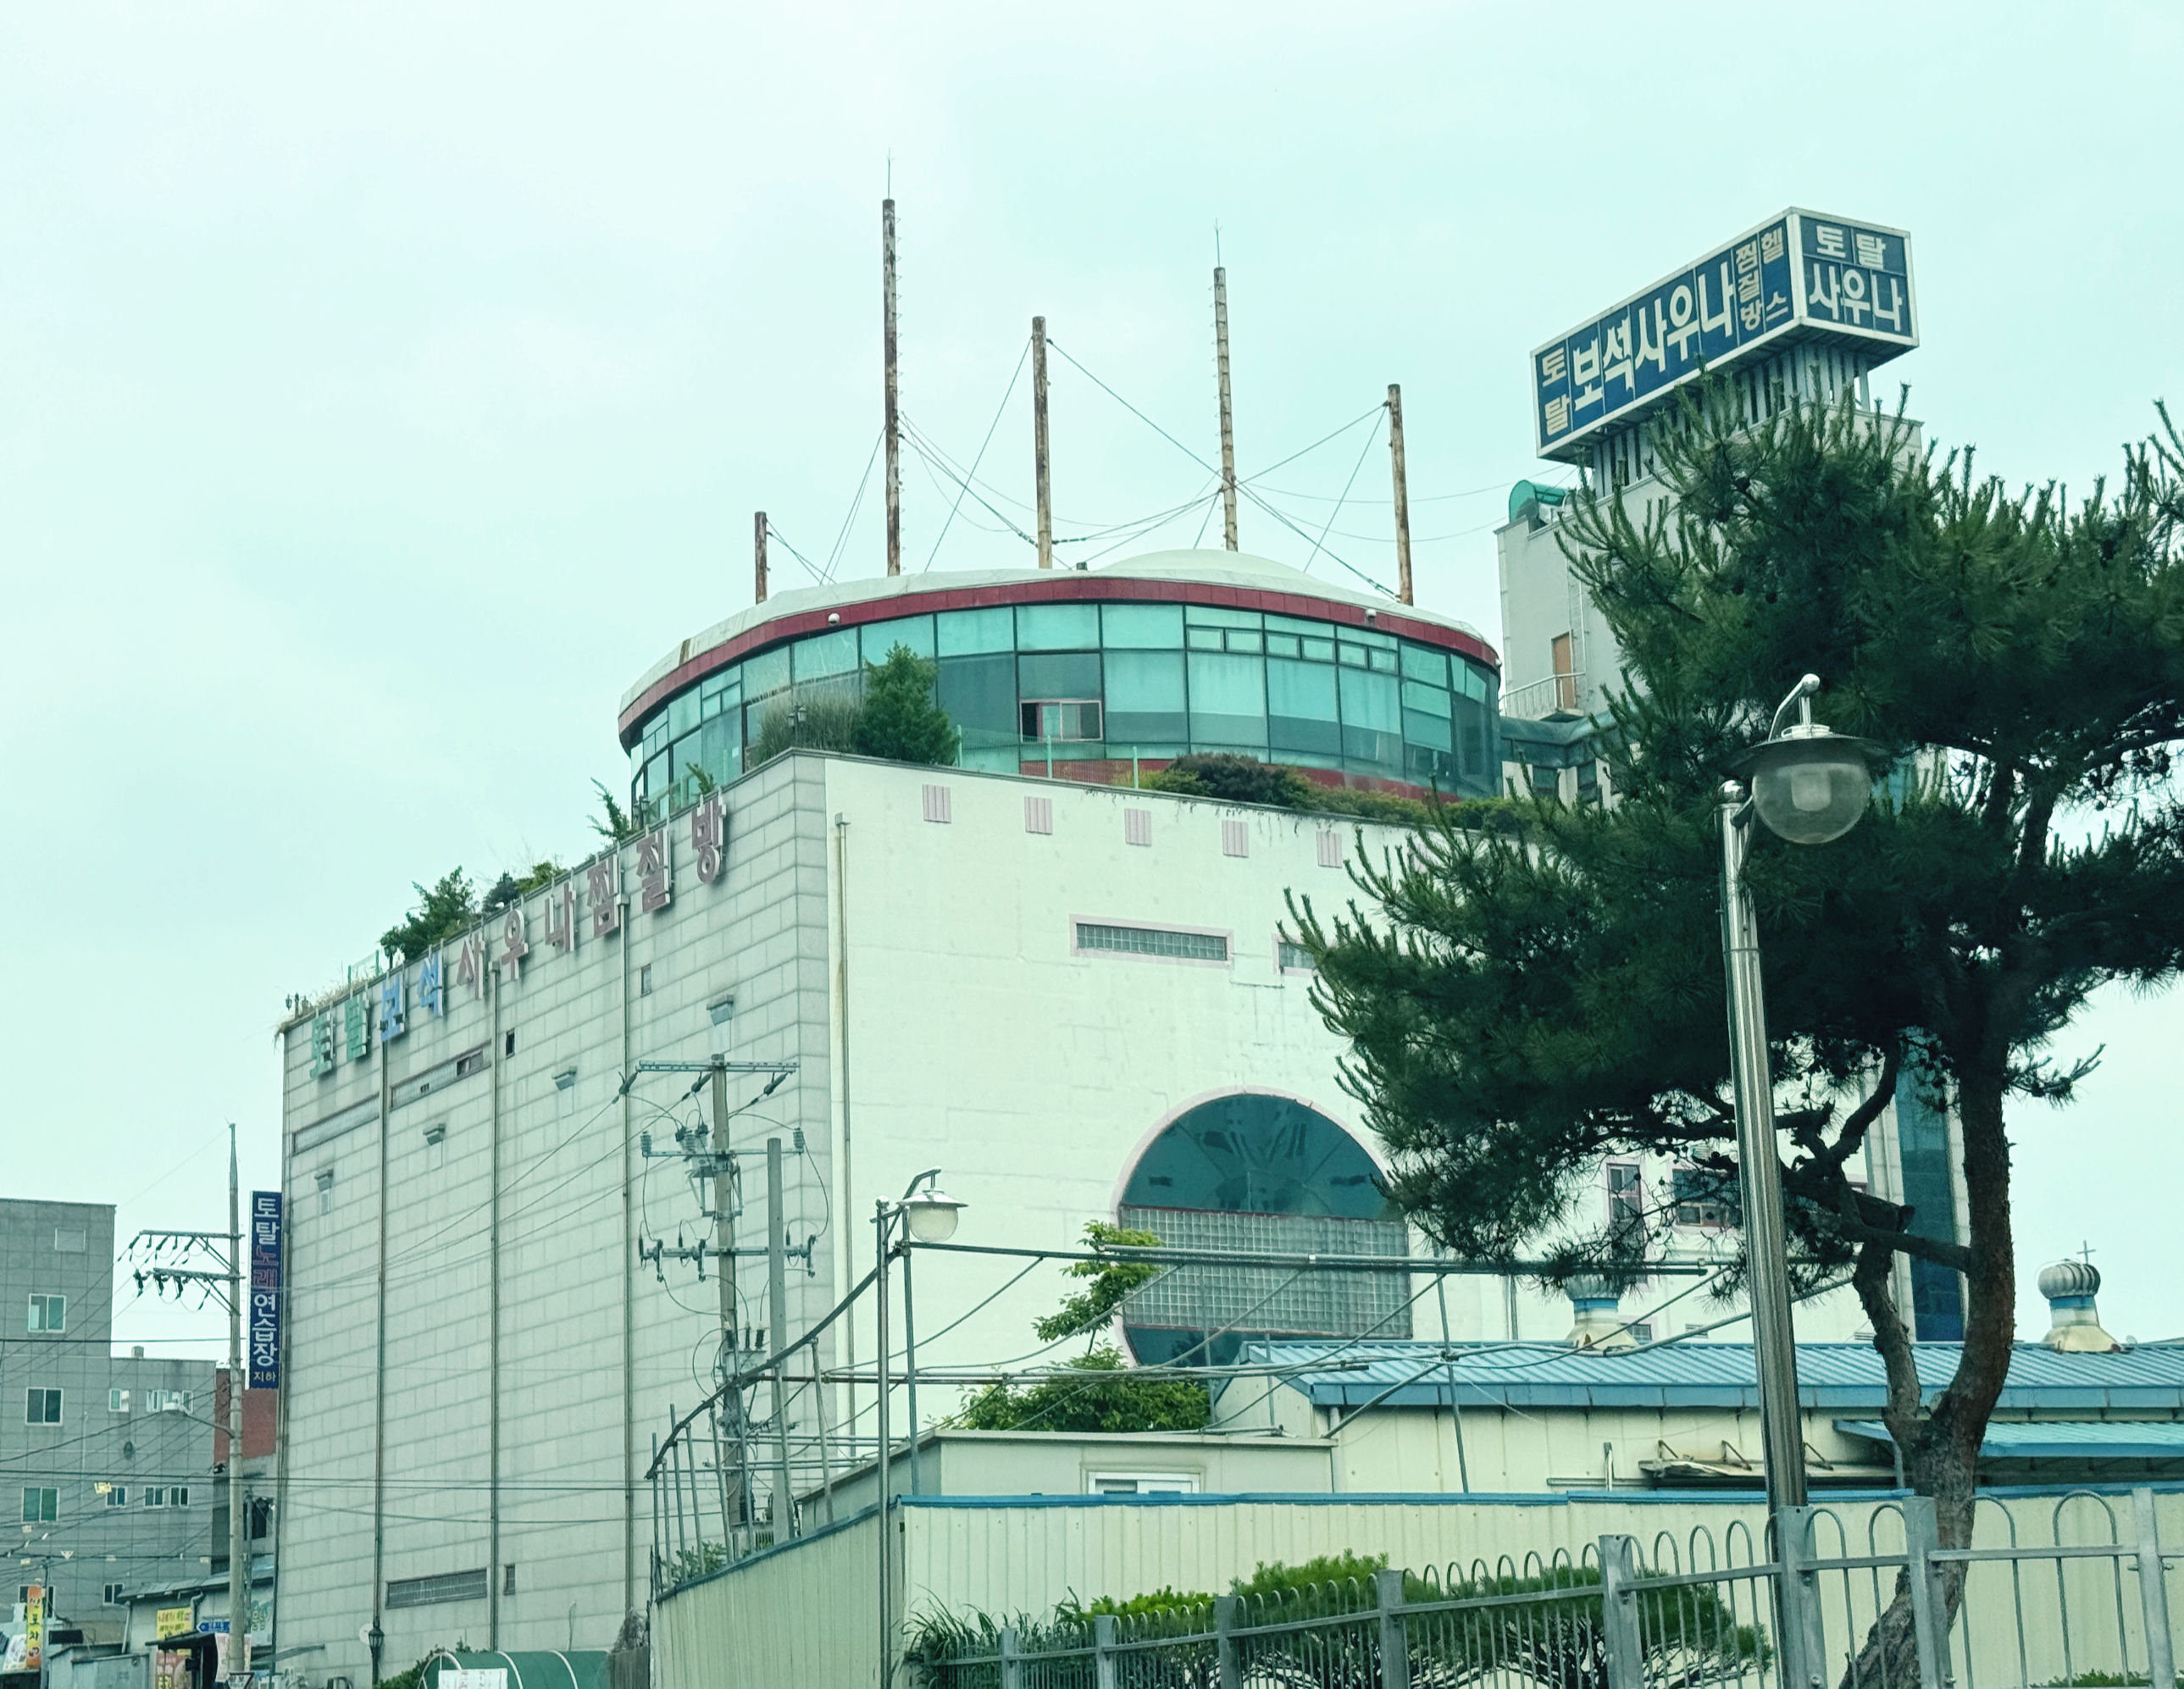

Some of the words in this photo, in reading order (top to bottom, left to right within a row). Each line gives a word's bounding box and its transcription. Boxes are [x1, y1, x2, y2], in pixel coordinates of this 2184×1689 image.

[1816, 224, 1886, 270] 토탈
[1809, 263, 1903, 331] 사우나
[254, 1371, 276, 1382] 지하
